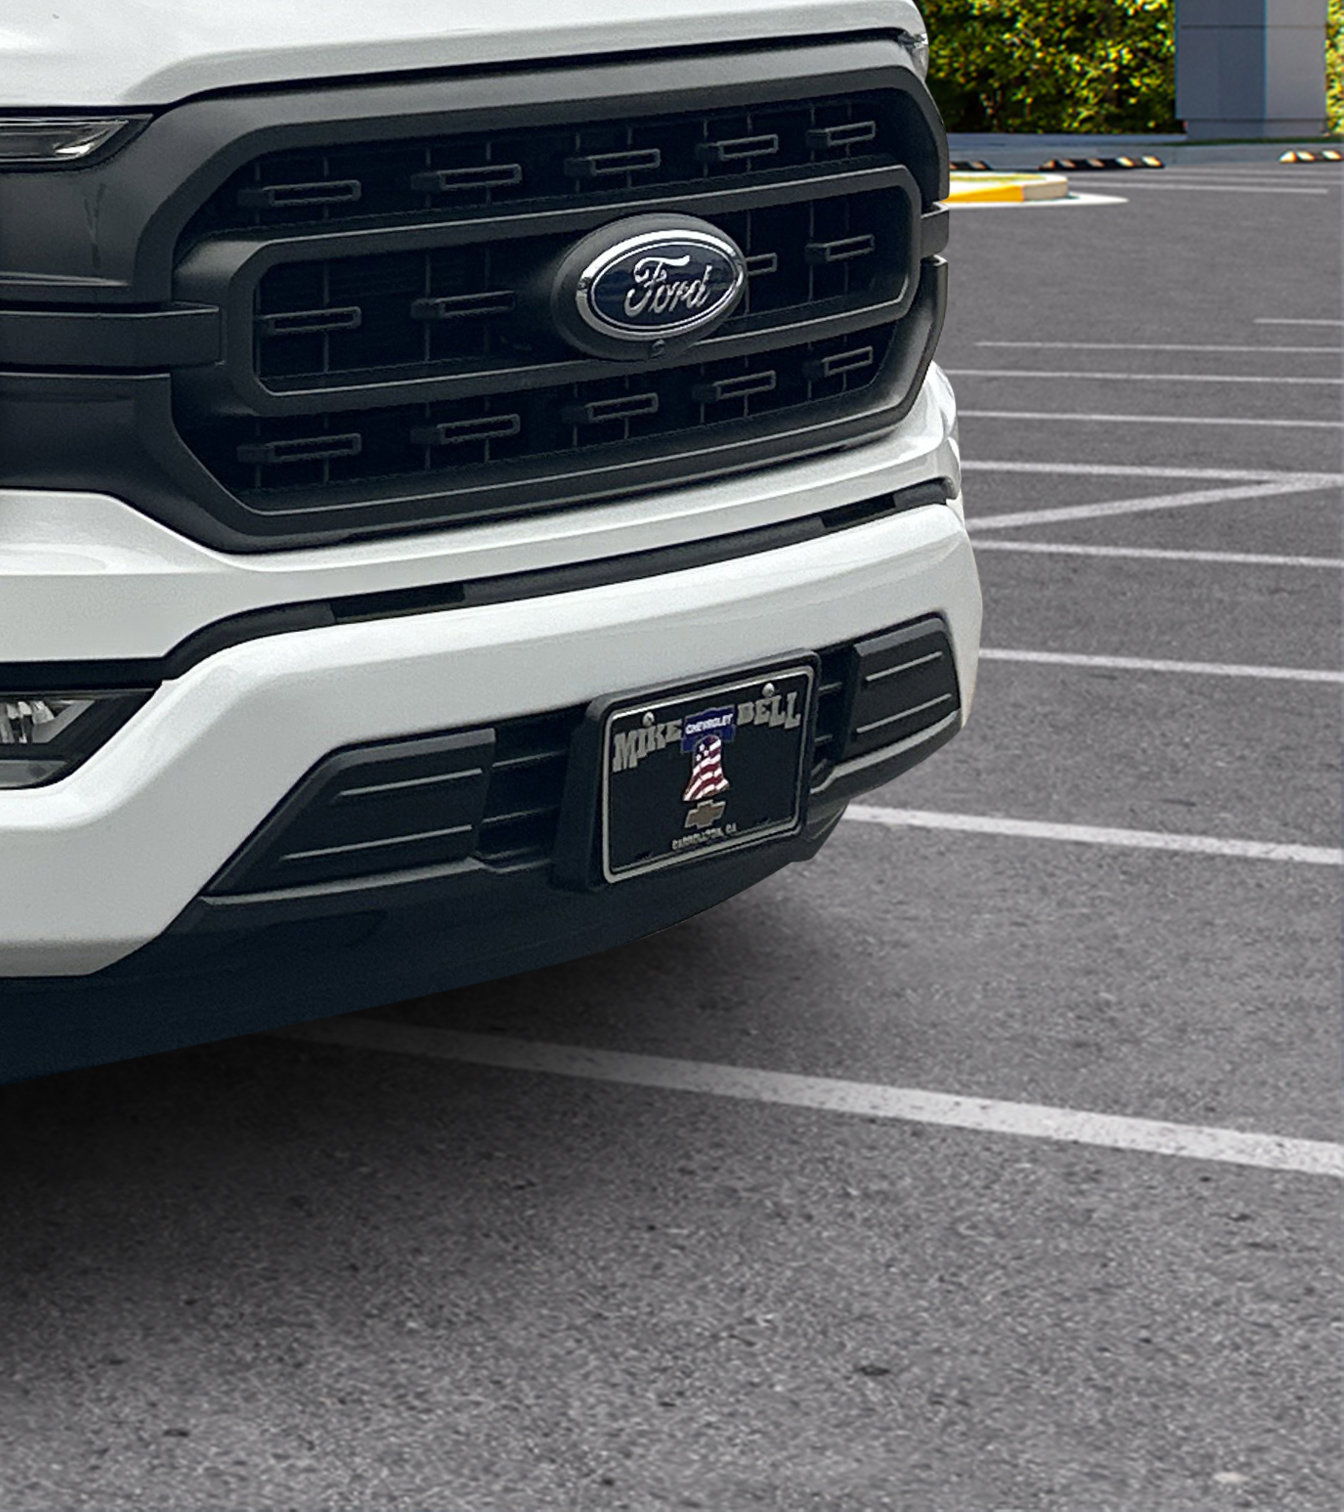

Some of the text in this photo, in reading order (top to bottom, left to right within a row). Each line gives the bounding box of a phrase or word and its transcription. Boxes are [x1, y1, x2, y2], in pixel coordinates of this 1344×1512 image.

[624, 255, 713, 318] Ford
[613, 691, 802, 772] MIKE BELL
